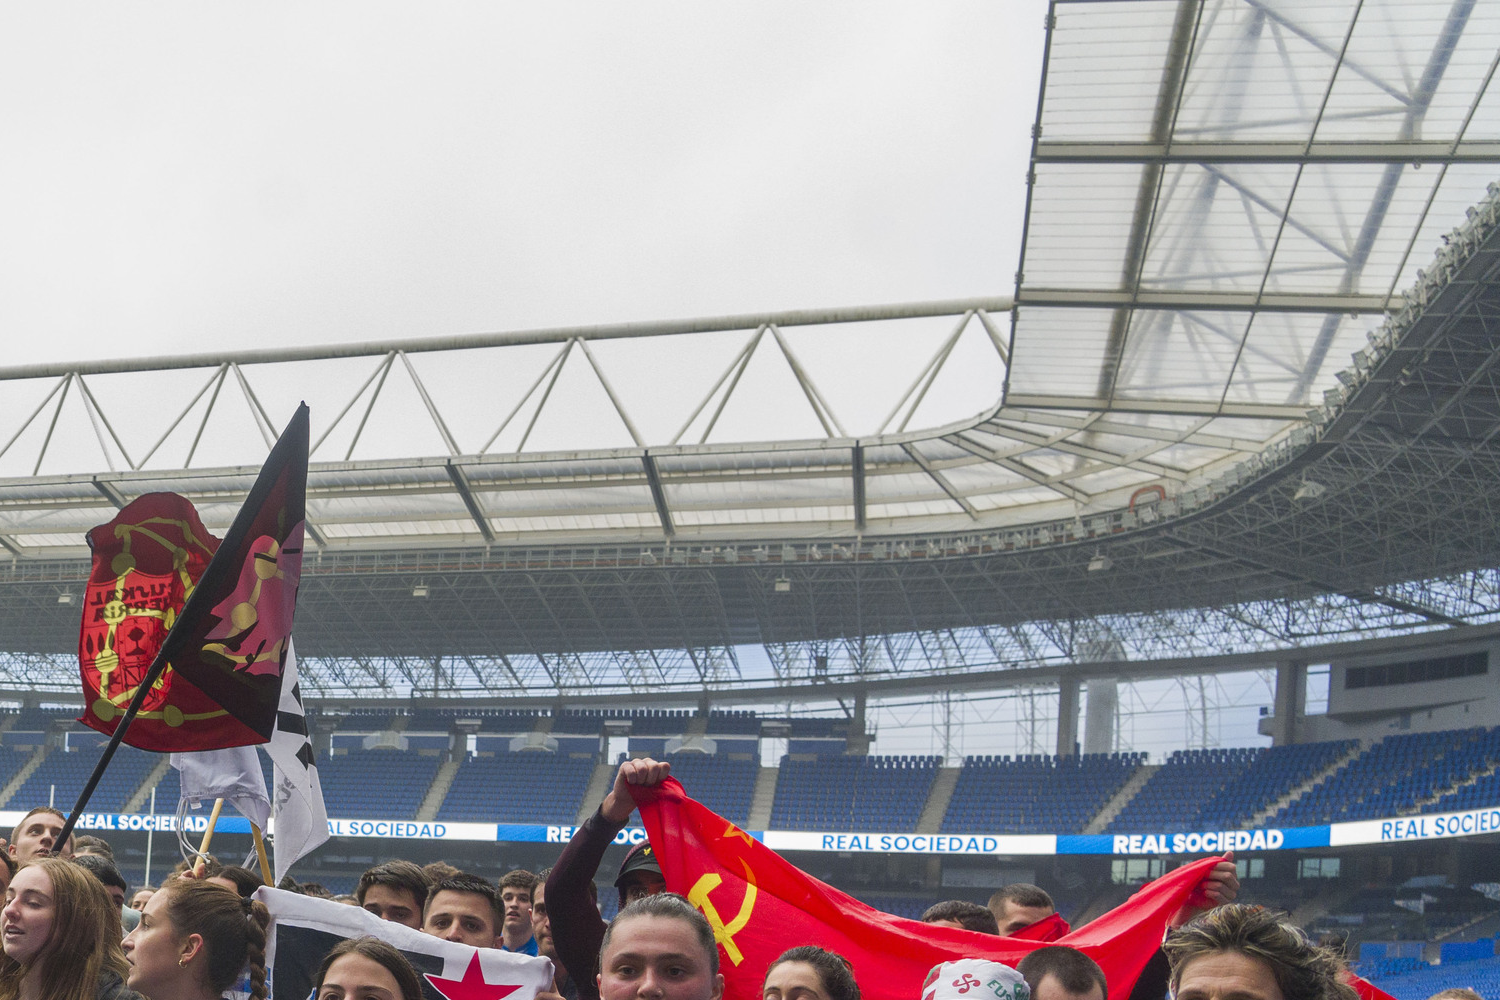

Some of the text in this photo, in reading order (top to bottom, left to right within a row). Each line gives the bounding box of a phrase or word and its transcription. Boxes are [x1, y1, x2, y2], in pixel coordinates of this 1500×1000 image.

[74, 813, 209, 832] REAL SOCIEDAD
[327, 820, 447, 838] AL SOCIEDAD
[1381, 810, 1500, 841] REAL SOCIED
[822, 835, 998, 852] REAL SOCIEDAD
[1113, 829, 1285, 854] REAL SOCIEDAD
